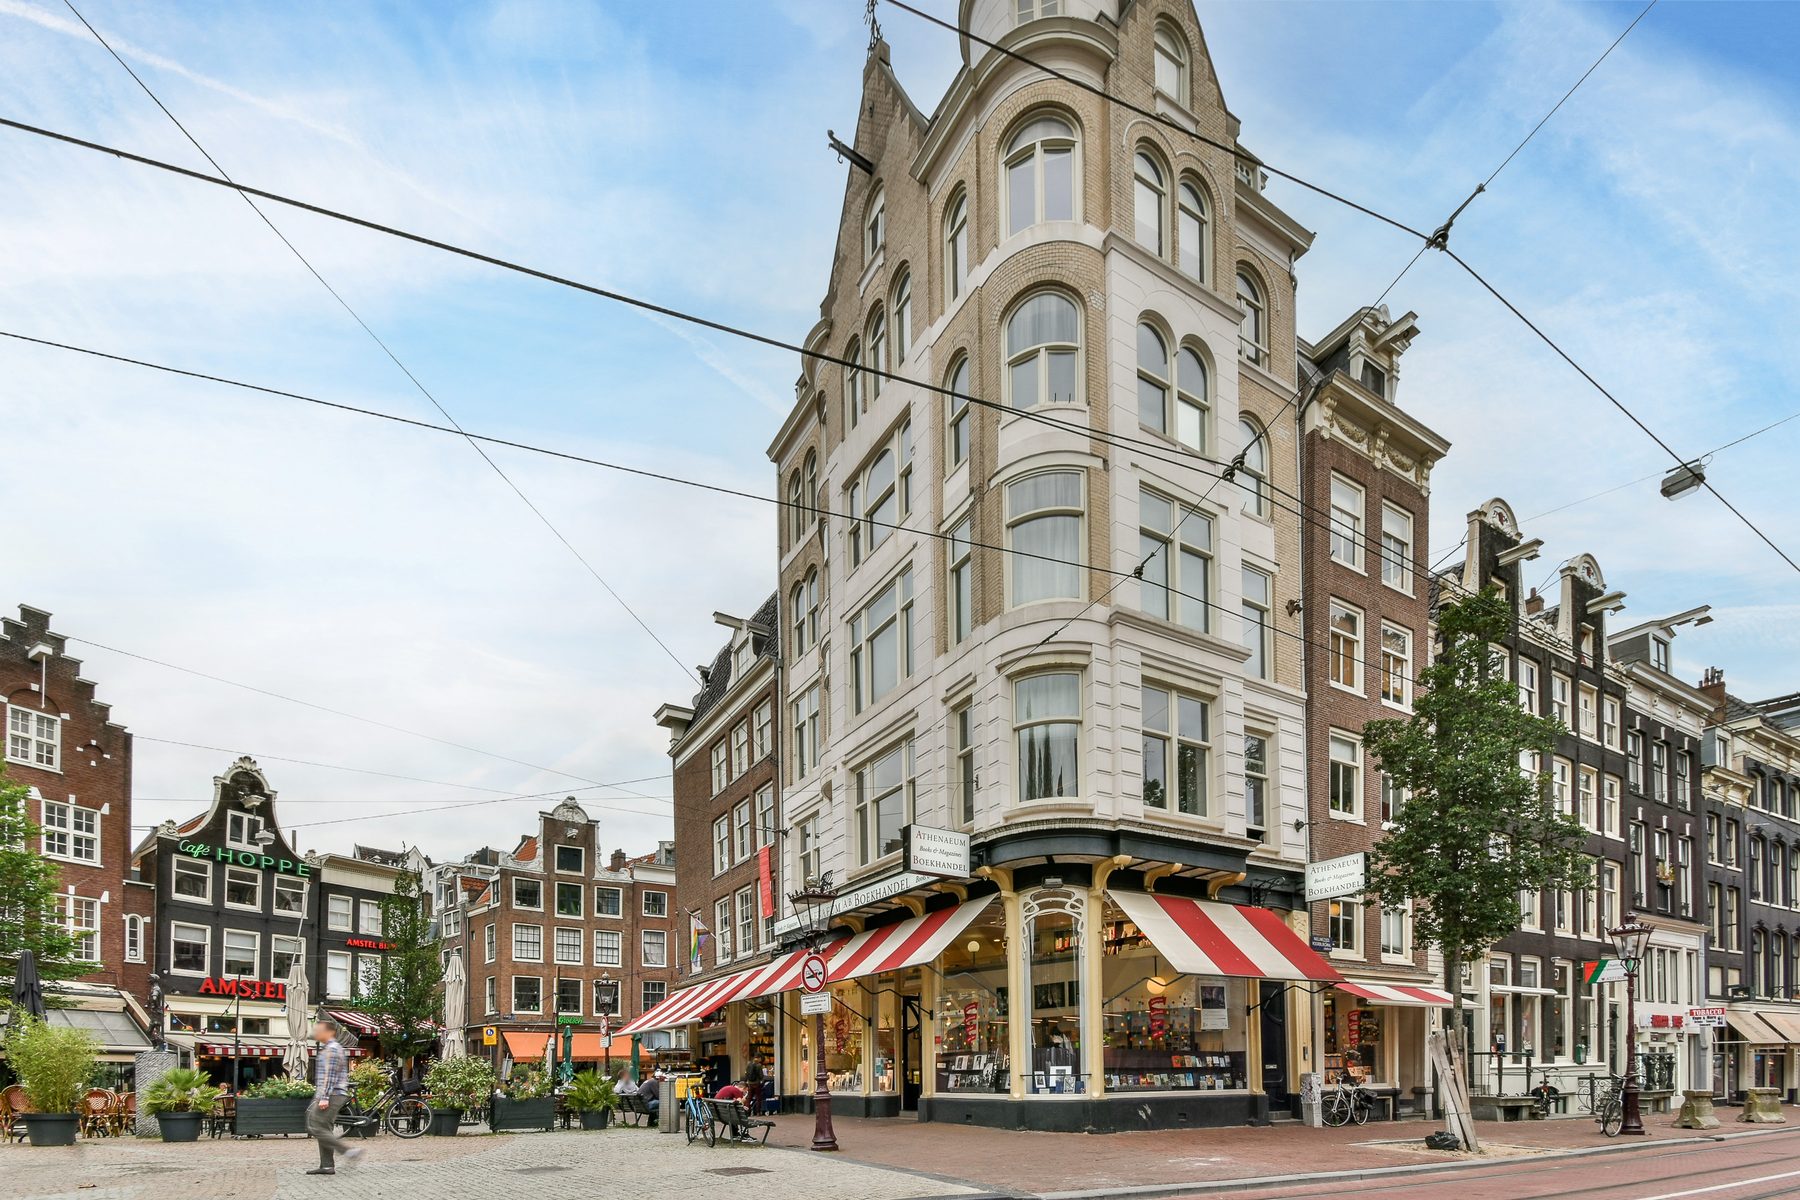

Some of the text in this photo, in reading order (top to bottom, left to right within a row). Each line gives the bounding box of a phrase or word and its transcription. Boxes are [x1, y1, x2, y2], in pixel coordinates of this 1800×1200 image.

[915, 830, 966, 847] ATHENAEUM
[919, 845, 932, 853] Books
[179, 839, 311, 877] Café HOPPE
[913, 855, 968, 872] BOEKHANDEL
[1310, 858, 1360, 875] ATHENAEUM
[854, 878, 910, 907] BOEKHANDEL
[1308, 880, 1361, 897] BOEKHANDEL
[346, 937, 377, 949] AMSTEL
[198, 976, 287, 999] AMSTEL
[1692, 1008, 1723, 1016] TOBACCO
